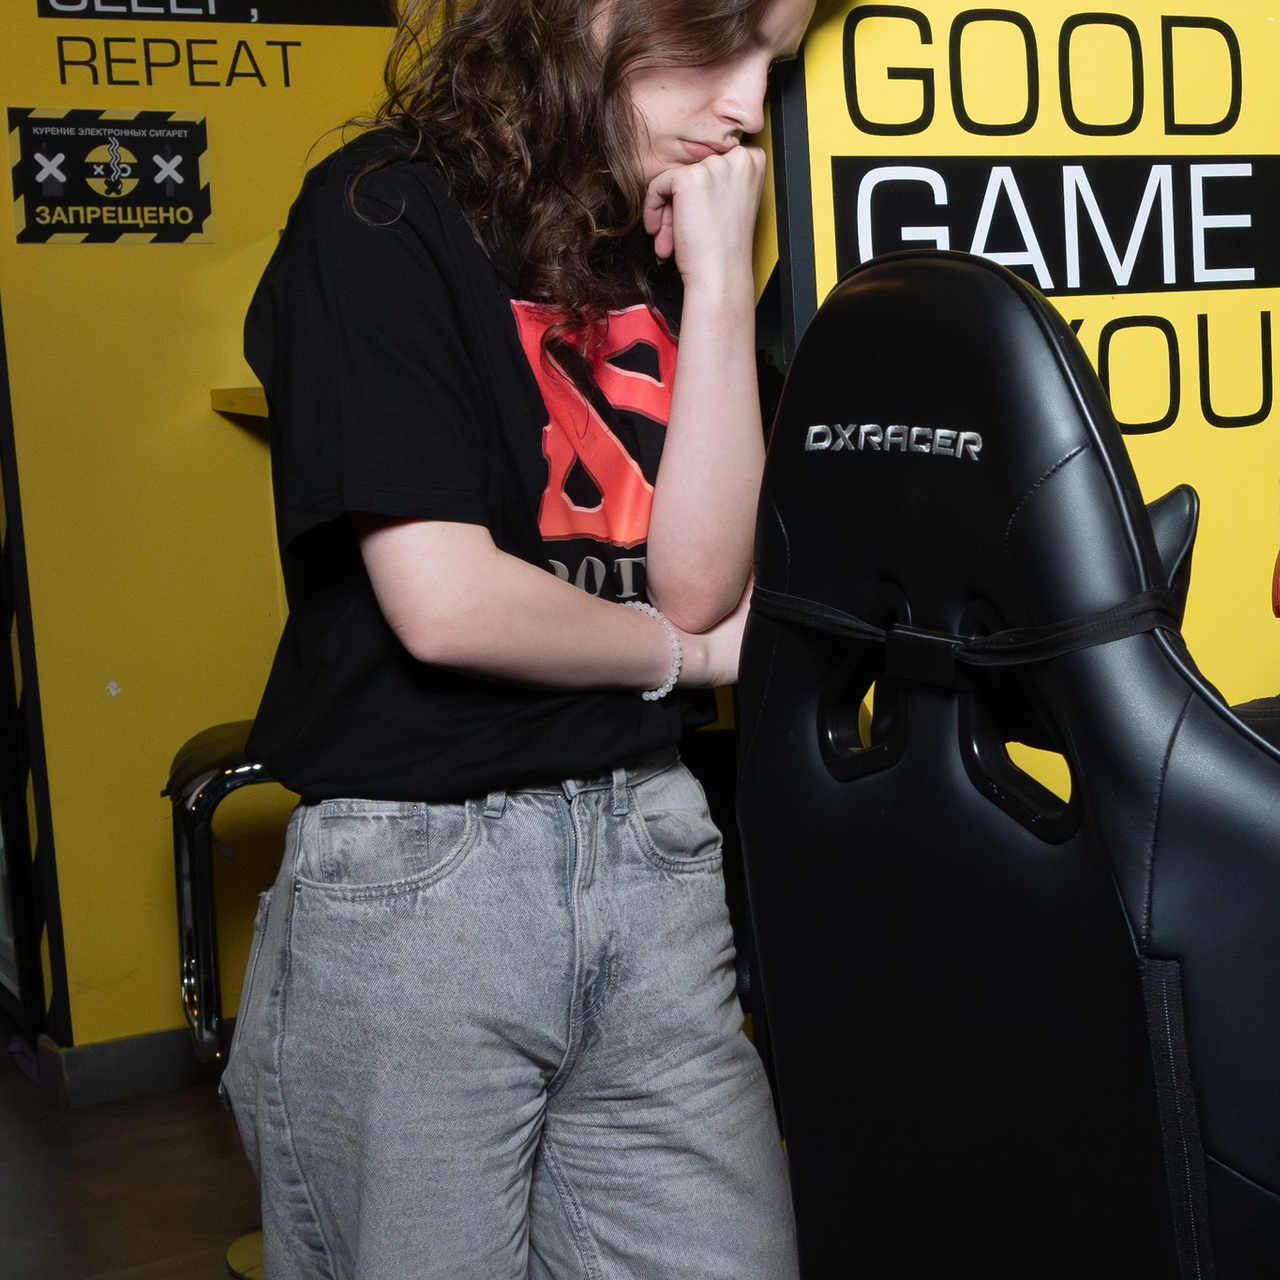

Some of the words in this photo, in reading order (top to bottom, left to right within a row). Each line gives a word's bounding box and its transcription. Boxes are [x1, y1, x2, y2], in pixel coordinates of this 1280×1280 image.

[56, 36, 302, 87] REPEAT
[842, 5, 1243, 136] GOOD
[32, 126, 75, 136] КУРЕНИЕ
[77, 127, 147, 138] ЭЛЕКТРОННЫХ
[149, 128, 188, 138] СИГАРЕТ
[35, 205, 193, 228] ЗАПРЕЩЕНО
[857, 163, 1255, 290] GAME
[805, 424, 983, 461] DXRACER
